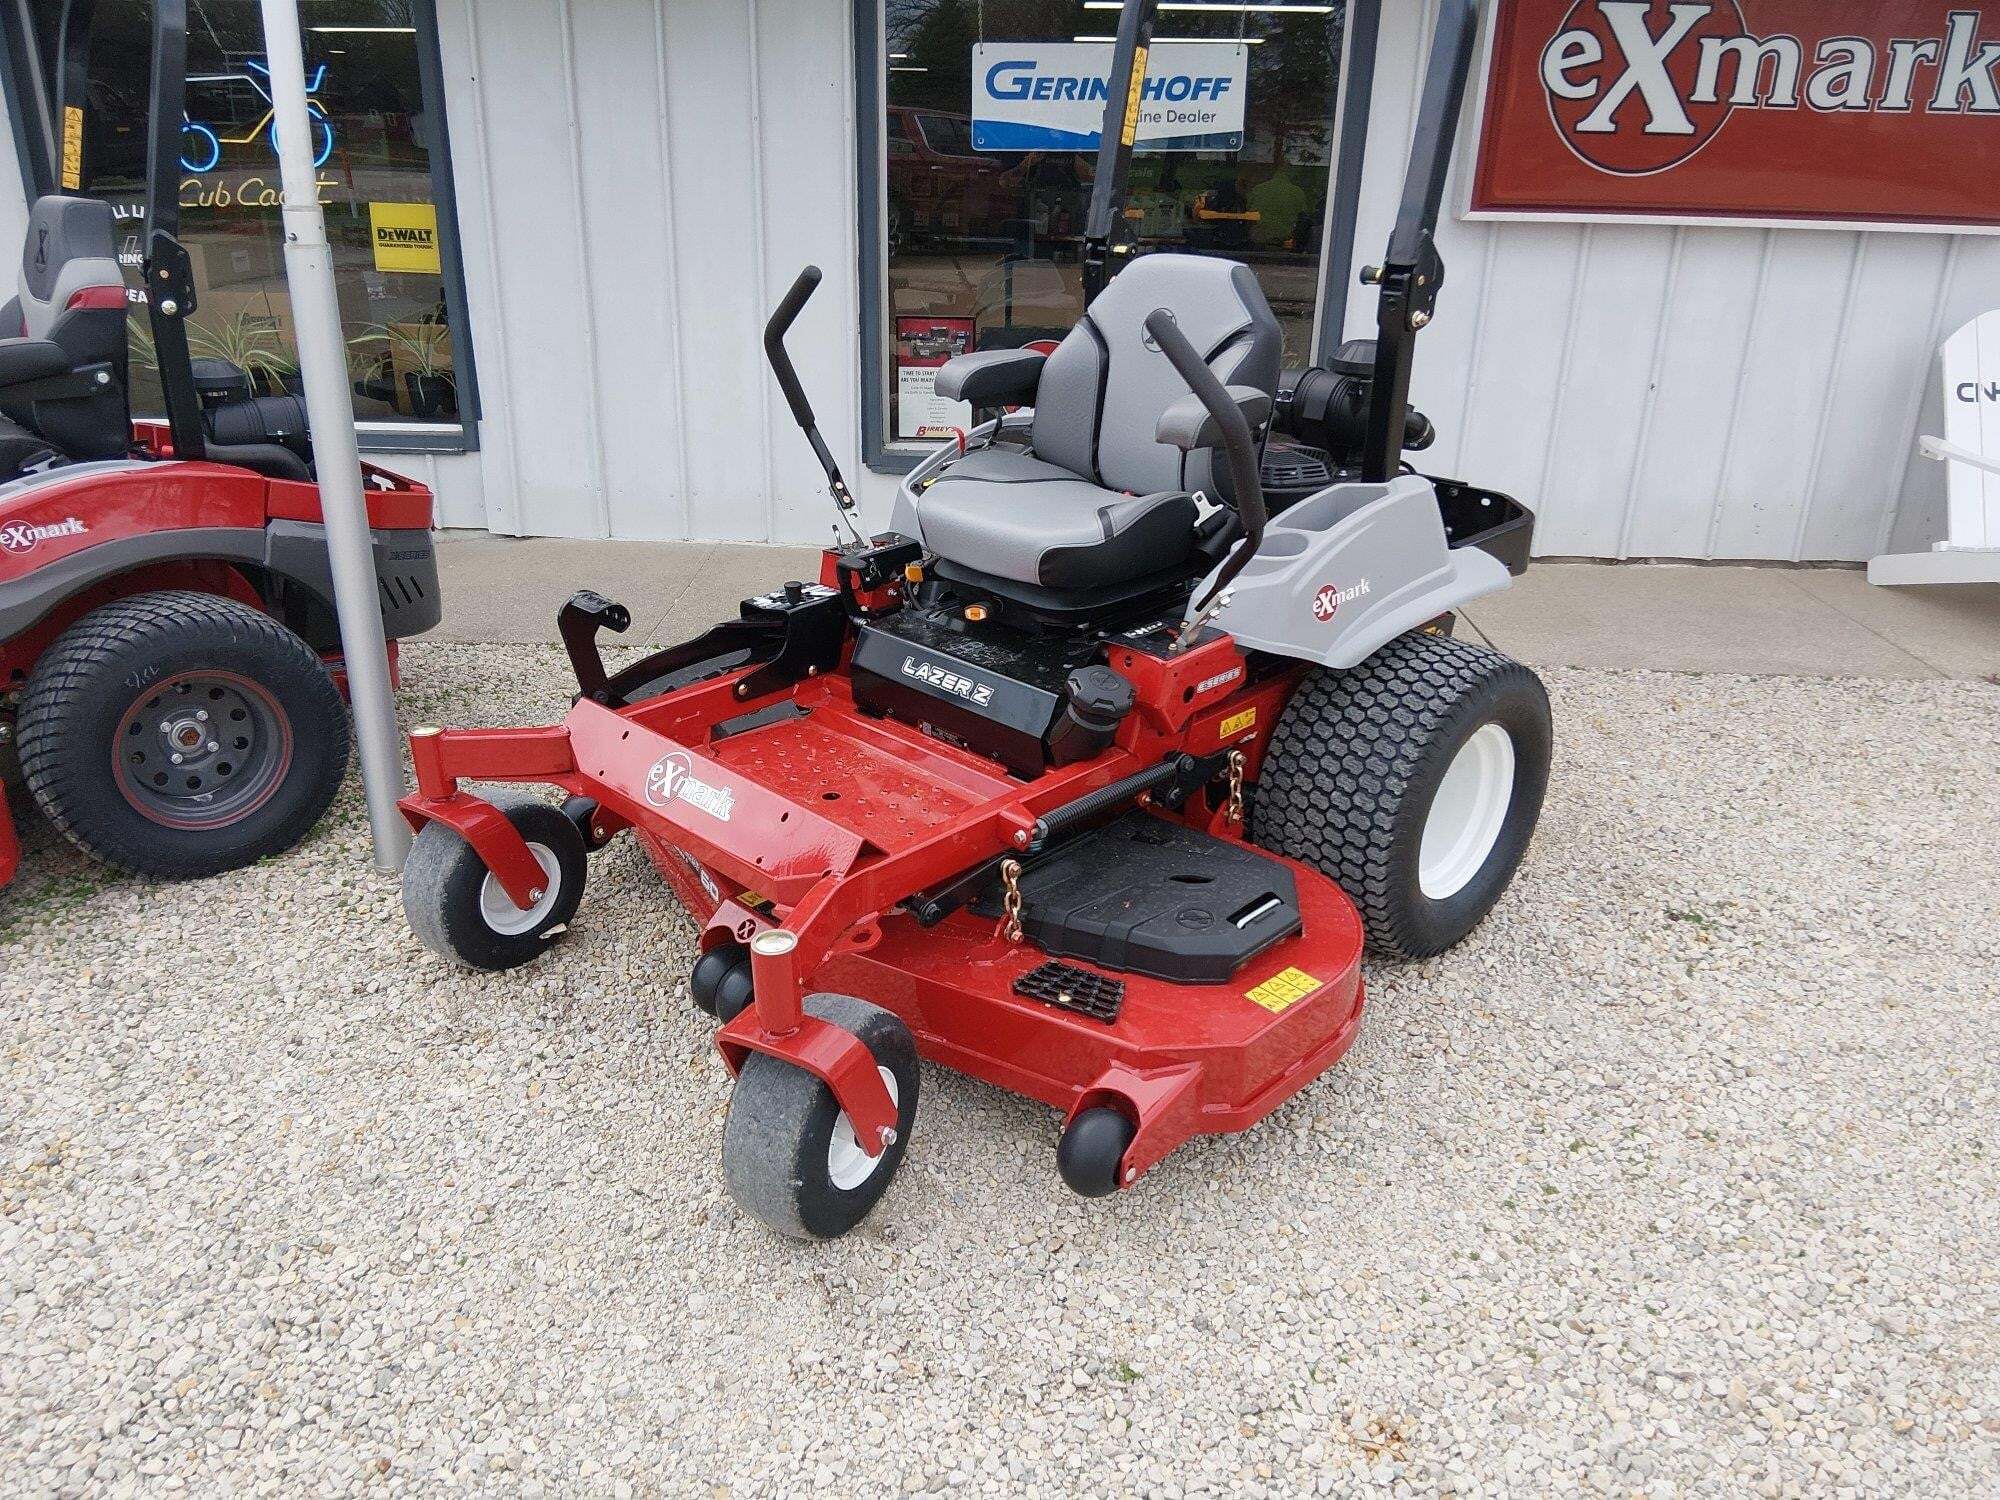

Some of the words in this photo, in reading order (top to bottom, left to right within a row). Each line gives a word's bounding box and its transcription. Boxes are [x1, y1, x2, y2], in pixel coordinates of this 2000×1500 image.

[985, 60, 1232, 101] GERINHOFF
[1139, 109, 1162, 123] ine
[1167, 110, 1216, 123] Dealer
[179, 179, 231, 207] Cub
[1312, 579, 1370, 617] eXmark
[901, 656, 973, 699] LAZER
[648, 760, 734, 821] eXmark
